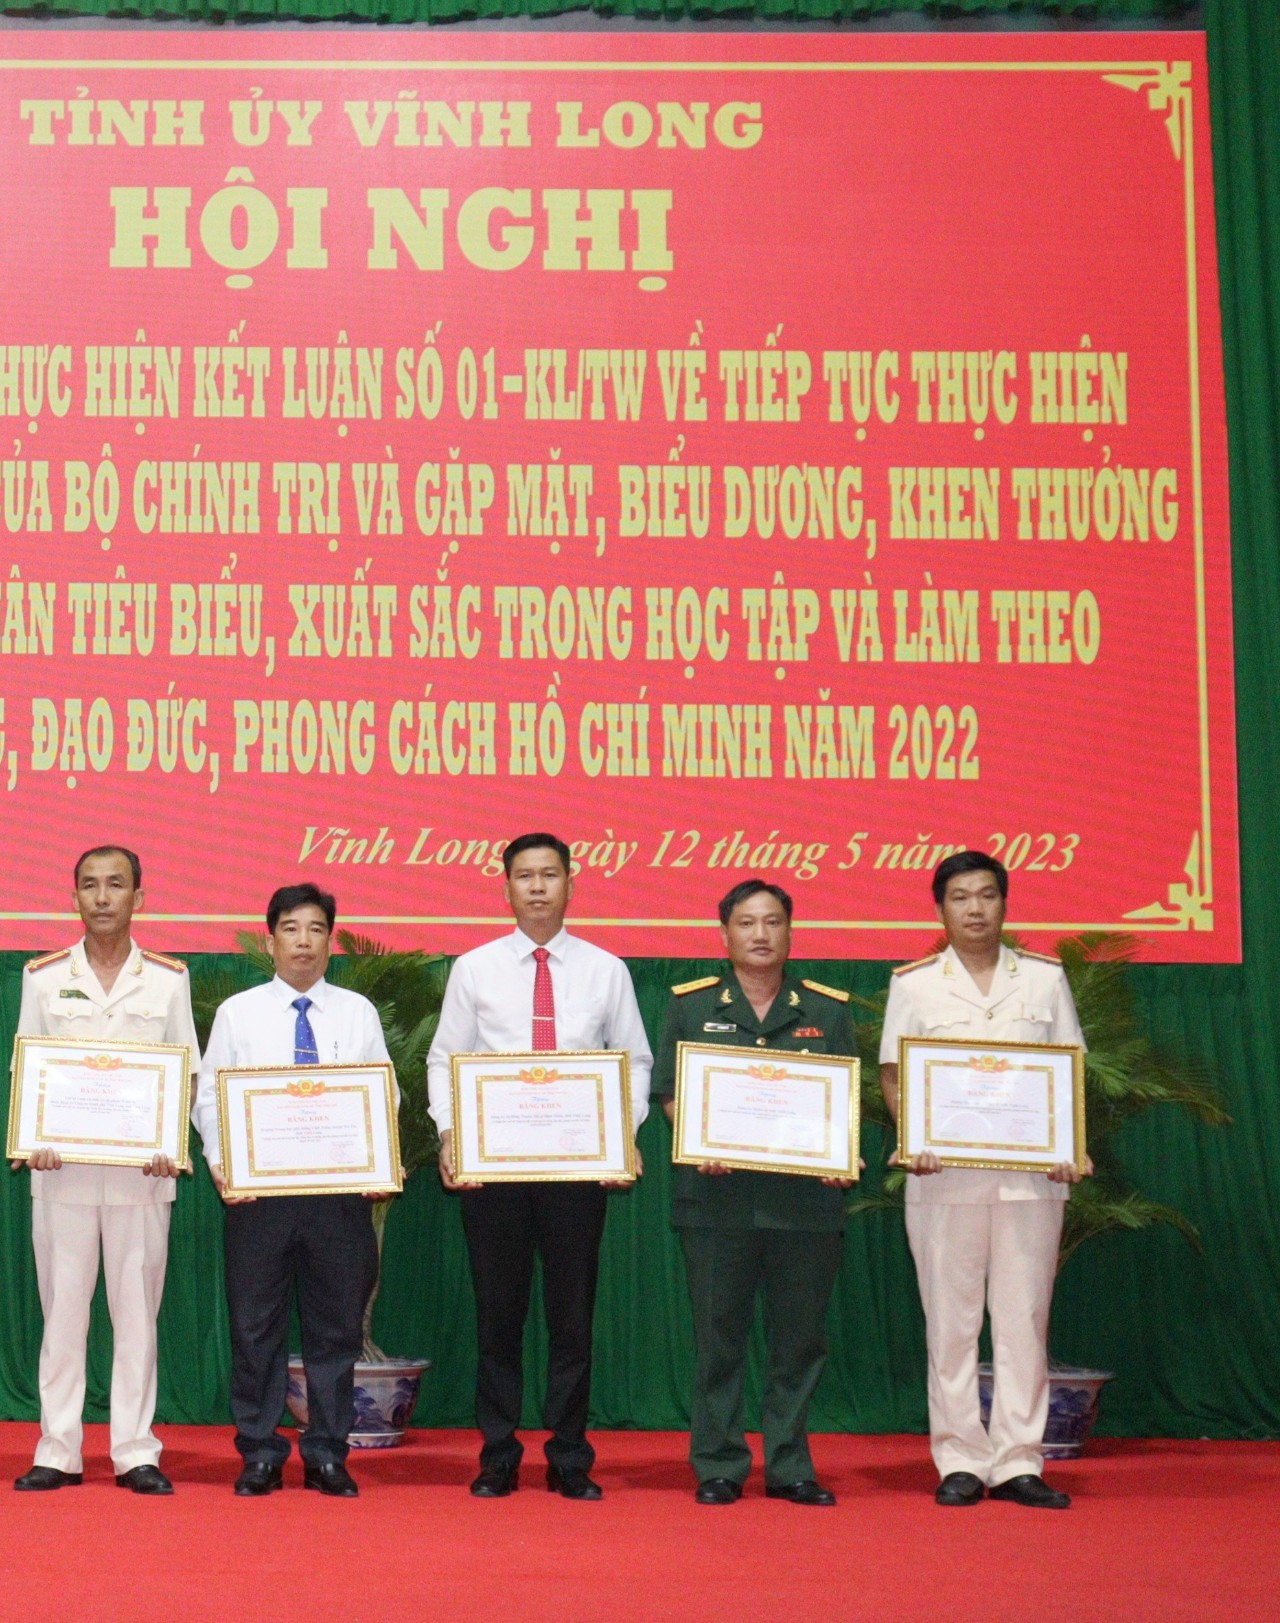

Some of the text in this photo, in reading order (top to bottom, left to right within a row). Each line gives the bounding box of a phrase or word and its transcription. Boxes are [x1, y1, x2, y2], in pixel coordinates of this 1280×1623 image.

[20, 87, 763, 149] TỈNH ỦY VĨNH LONG
[109, 166, 673, 291] HỘI NGHỊ
[84, 328, 182, 435] HIỆN
[193, 320, 271, 418] KẾT
[282, 330, 384, 437] LUẬN
[395, 321, 444, 420] SỐ
[456, 347, 647, 421] 01-KL/TW
[657, 320, 707, 421] VỀ
[719, 324, 811, 422] TIẾP
[823, 350, 899, 440] TỤC
[912, 351, 1017, 440] THỰC
[1030, 335, 1127, 441] HIỆN
[64, 443, 120, 550] BỘ
[133, 445, 260, 534] CHÍNH
[272, 462, 341, 552] TRỊ
[352, 446, 403, 535] VÀ
[415, 448, 495, 554] GẶP
[507, 449, 605, 556] MẶT,
[619, 435, 711, 538] BIỂU
[724, 464, 876, 558] DƯƠNG,
[889, 467, 1000, 540] KHEN
[1012, 446, 1178, 541] THƯỞNG
[68, 565, 157, 656] TIÊU
[170, 553, 275, 676] BIỂU,
[288, 559, 397, 658] XUẤT
[410, 552, 481, 659] SẮC
[494, 585, 633, 661] TRONG
[645, 587, 729, 678] HỌC
[742, 571, 820, 680] TẬP
[831, 572, 883, 662] VÀ
[894, 572, 980, 662] LÀM
[992, 590, 1100, 664] THEO
[31, 697, 114, 788] ĐẠO
[127, 682, 219, 793] ĐỨC,
[233, 699, 375, 774] PHONG
[388, 684, 496, 775] CÁCH
[509, 672, 566, 776] HỒ
[579, 687, 650, 777] CHÍ
[662, 704, 772, 778] MINH
[784, 689, 875, 779] NĂM
[889, 705, 979, 780] 2022
[298, 826, 396, 865] Vĩnh
[650, 830, 701, 868] 12
[707, 830, 829, 880] tháng
[838, 832, 868, 870] 5
[987, 832, 1080, 872] 2023
